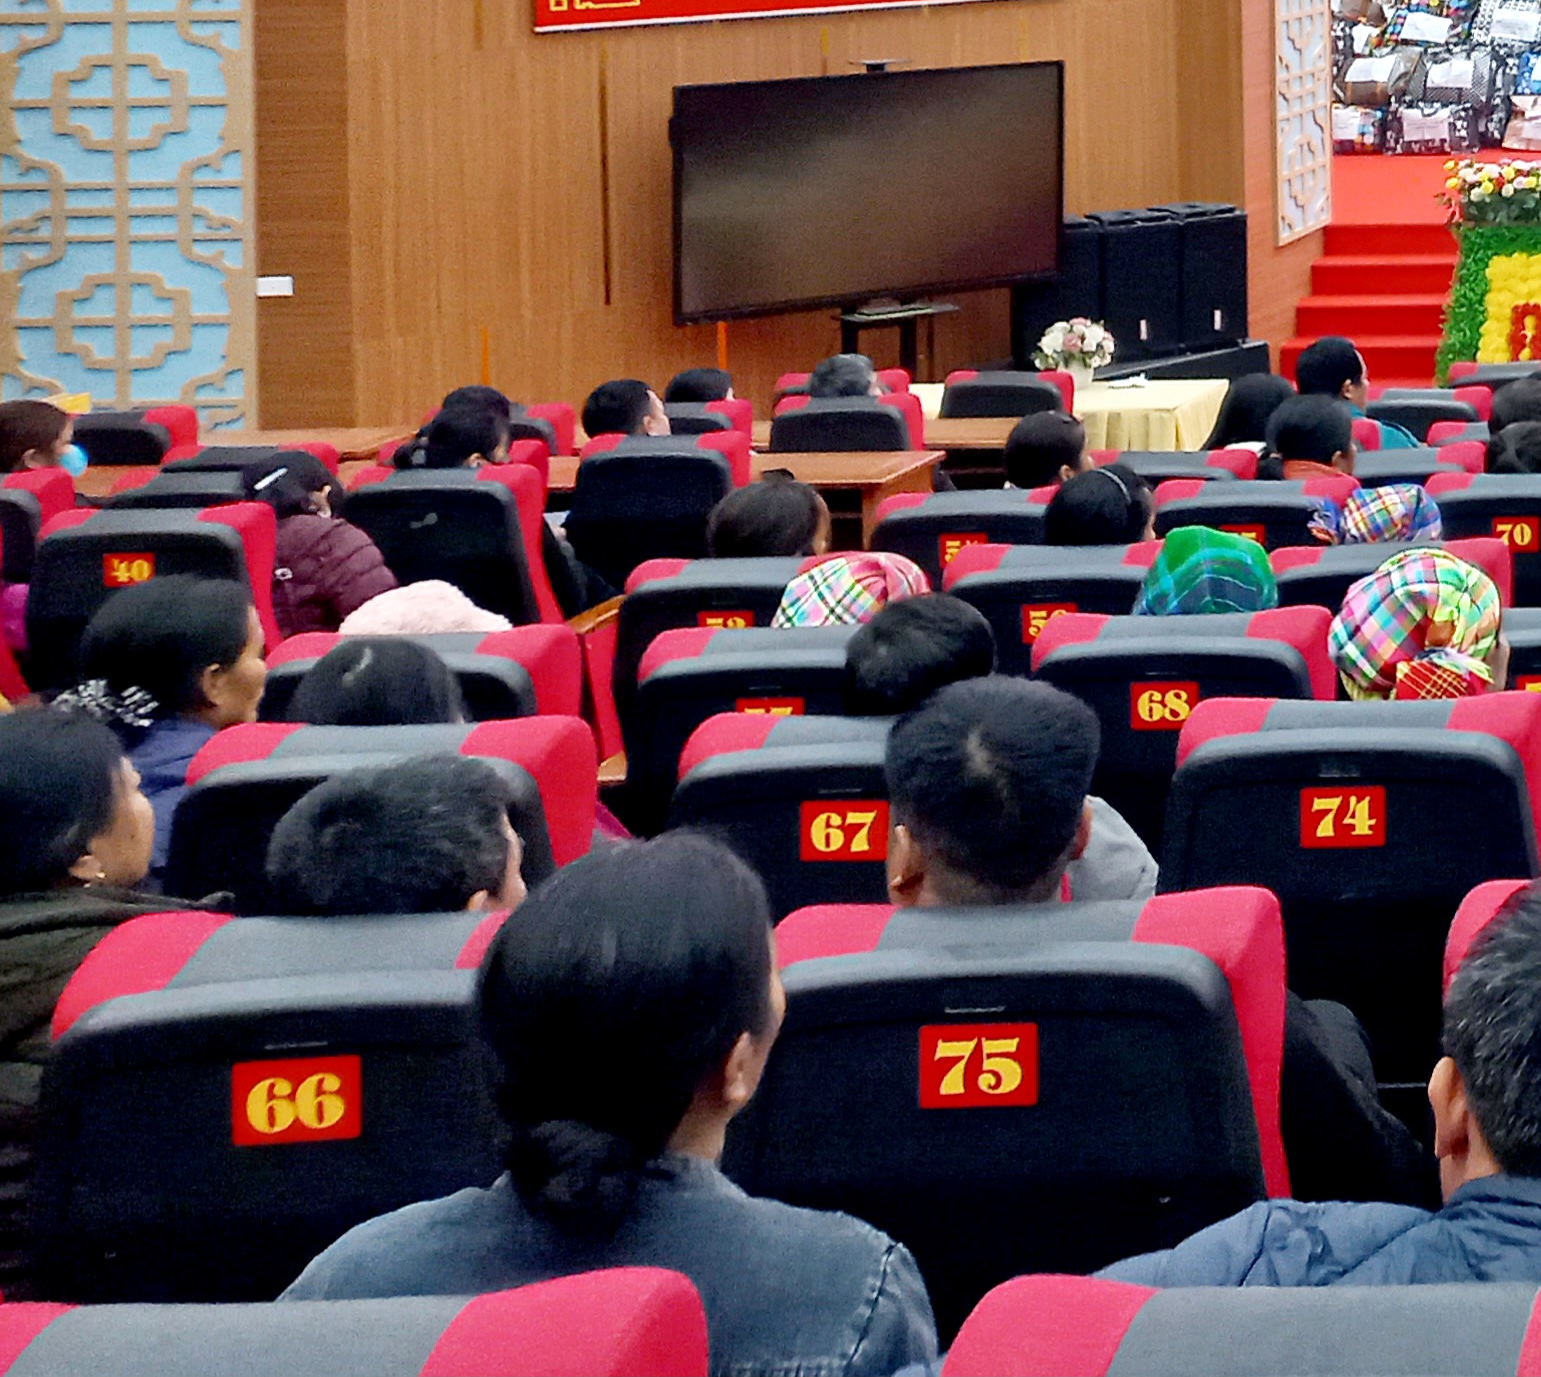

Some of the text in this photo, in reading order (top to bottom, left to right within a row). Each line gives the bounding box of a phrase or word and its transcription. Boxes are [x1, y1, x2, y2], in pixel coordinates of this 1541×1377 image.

[112, 559, 151, 582] 40
[1137, 689, 1193, 722] 68
[810, 810, 877, 853] 67
[1311, 795, 1377, 838] 74
[934, 1037, 1022, 1095] 75
[246, 1073, 345, 1133] 66
